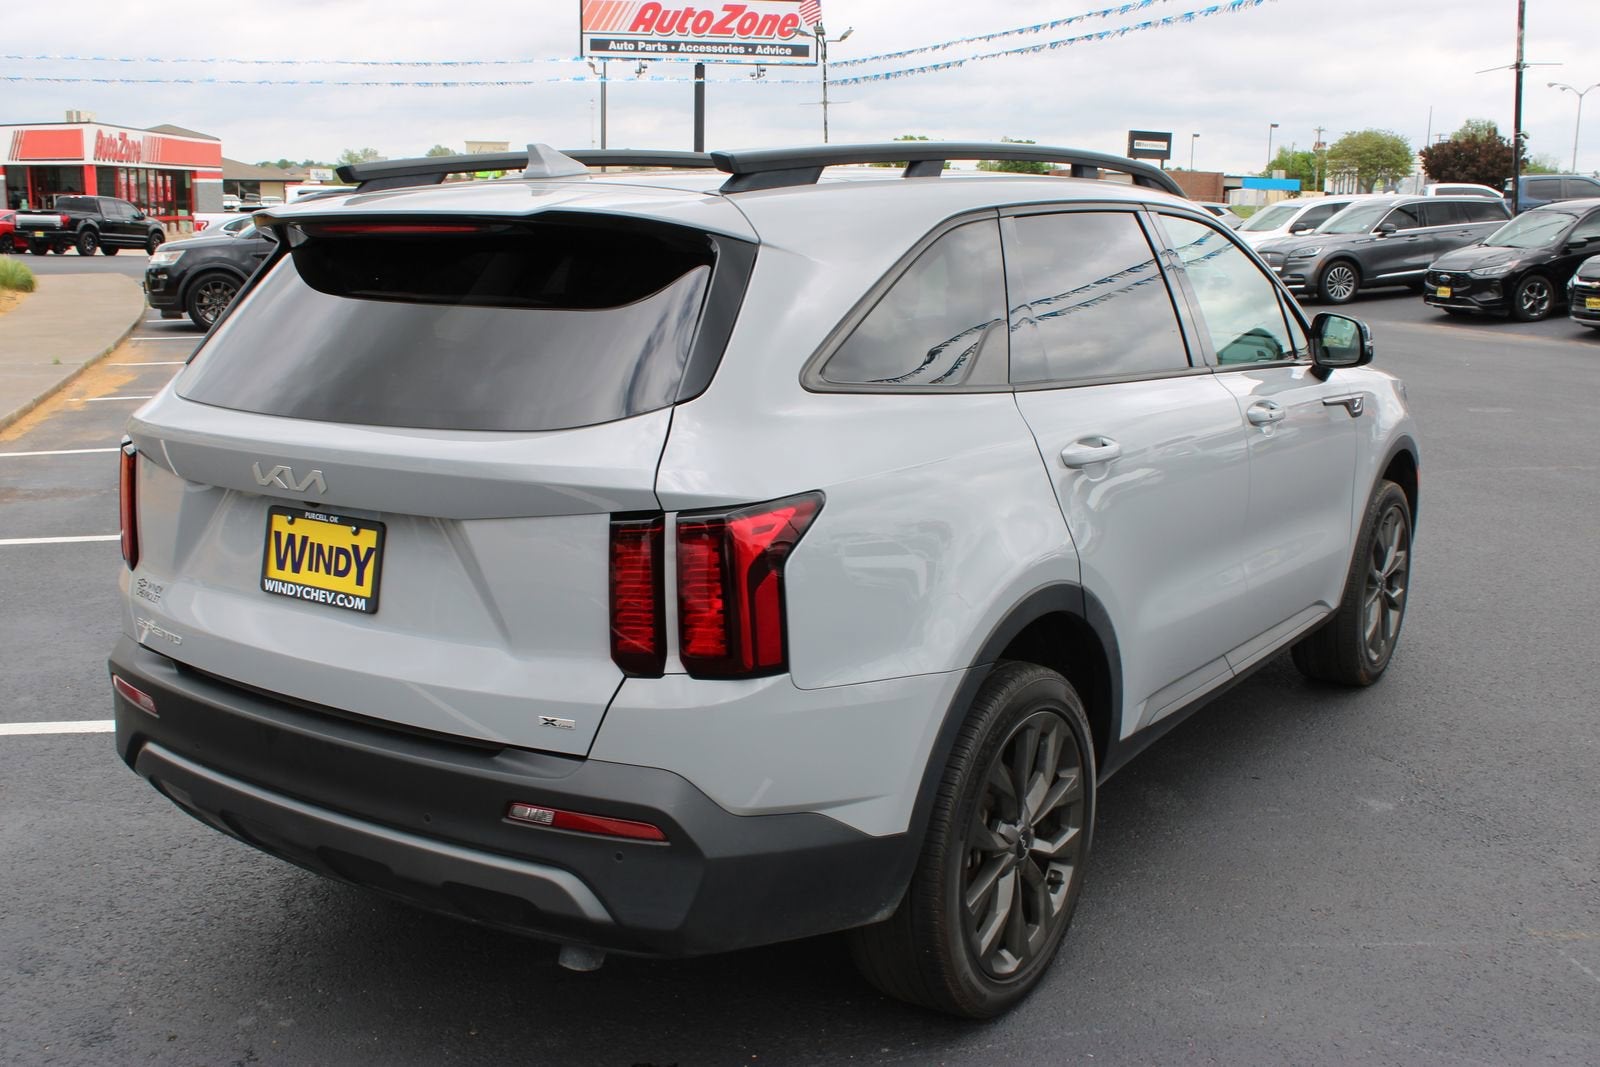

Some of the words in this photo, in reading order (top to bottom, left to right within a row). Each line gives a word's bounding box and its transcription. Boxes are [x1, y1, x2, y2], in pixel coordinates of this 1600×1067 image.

[628, 1, 801, 38] AutoZone
[608, 40, 635, 51] Auto
[637, 41, 668, 52] Parts
[678, 42, 745, 54] Accessories
[755, 45, 792, 56] Advice
[94, 129, 142, 163] AutoZone
[329, 515, 339, 523] OK
[274, 530, 376, 587] WINDY
[264, 579, 366, 611] WINDYCHEV.COM
